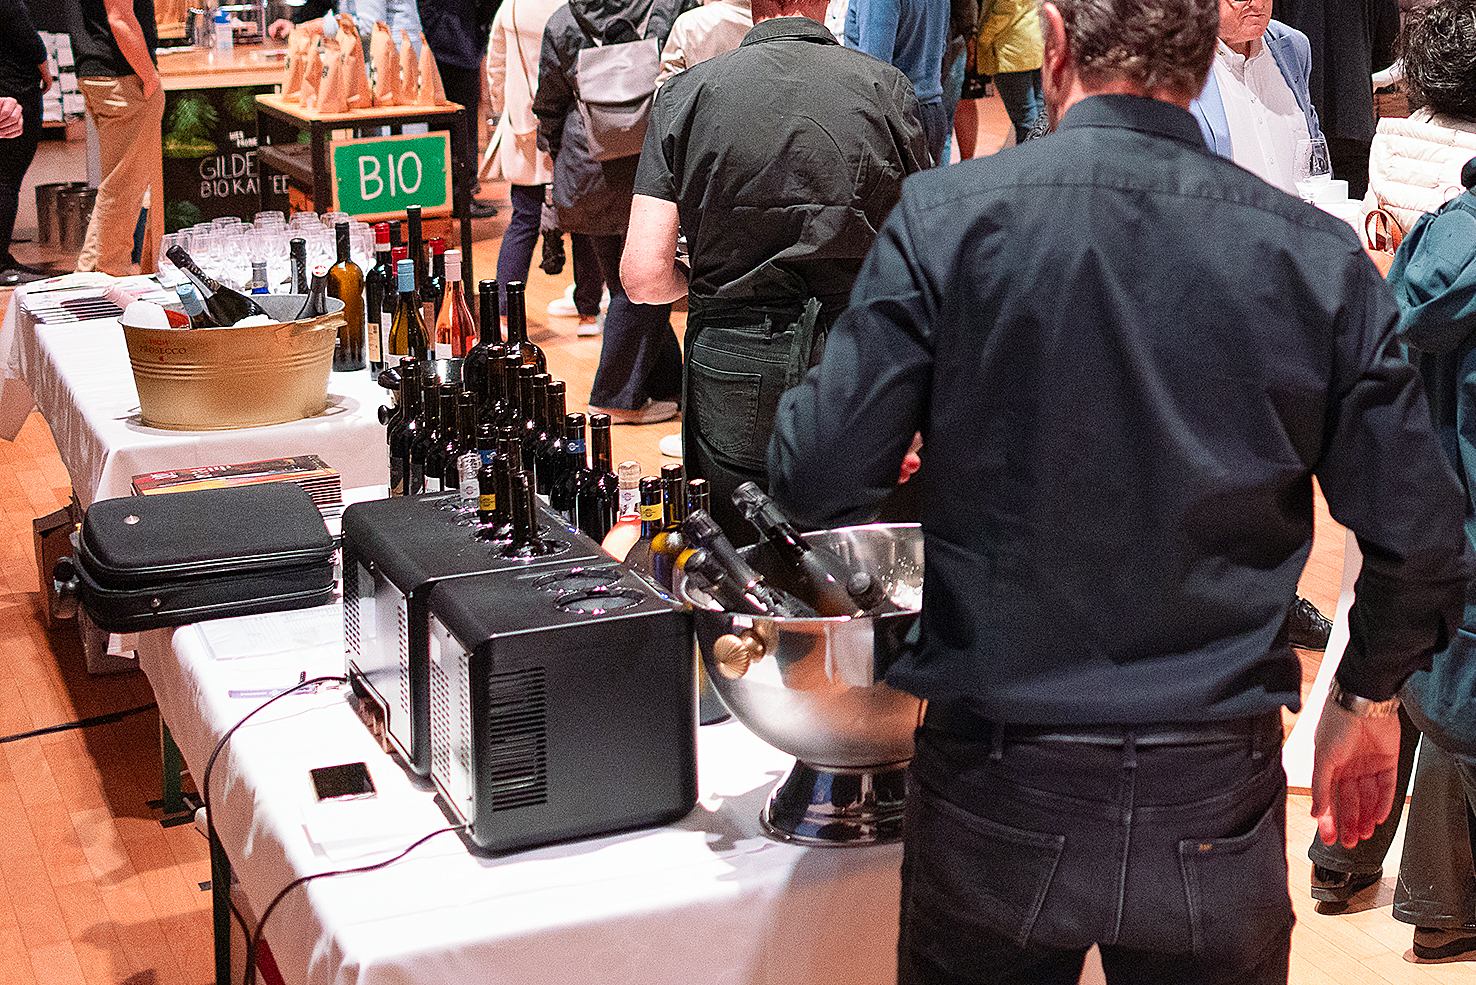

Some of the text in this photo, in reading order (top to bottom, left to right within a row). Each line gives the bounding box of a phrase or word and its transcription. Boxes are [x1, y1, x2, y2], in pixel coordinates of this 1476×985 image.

[200, 152, 258, 180] GILDE
[358, 150, 423, 201] BIO
[233, 174, 290, 195] KAEE
